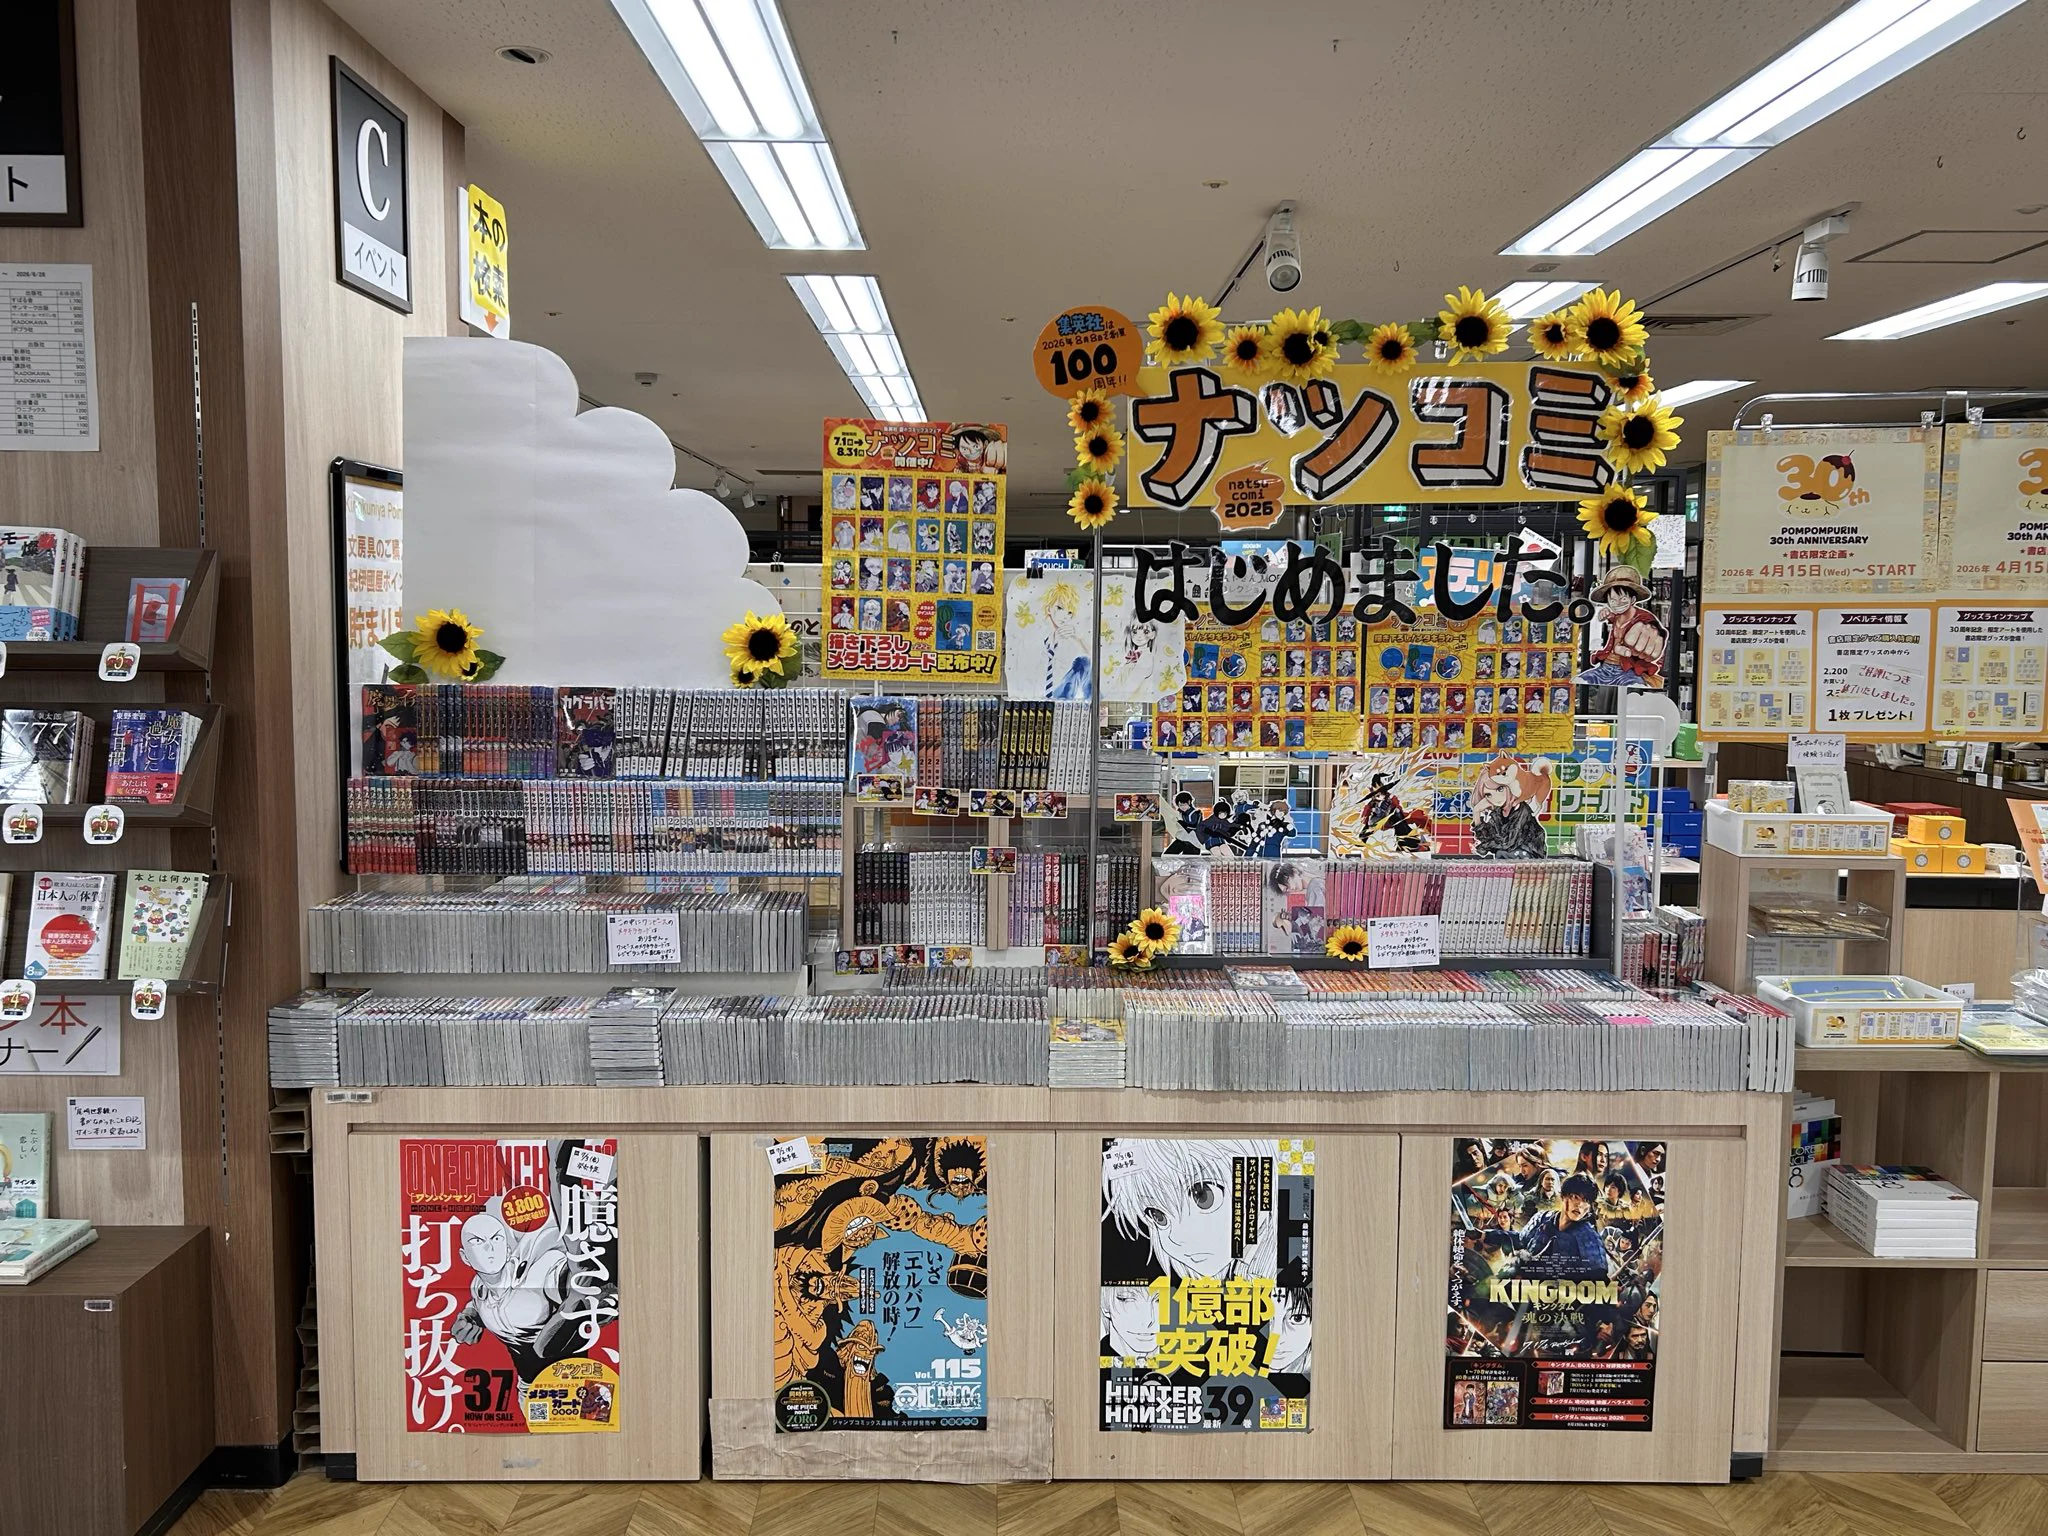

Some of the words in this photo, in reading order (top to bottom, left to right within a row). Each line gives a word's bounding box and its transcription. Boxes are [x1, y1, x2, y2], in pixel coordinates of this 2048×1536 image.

[356, 118, 391, 221] C
[8, 166, 28, 202] ト
[472, 199, 508, 250] 本の
[353, 242, 398, 283] イベント
[472, 254, 508, 309] 検索
[1050, 343, 1118, 386] 100
[865, 430, 957, 458] ナツコミ
[1128, 366, 1614, 508] ナツコミ
[894, 456, 934, 468] 開催中!
[1229, 478, 1269, 490] natsu
[1232, 489, 1264, 501] comi
[1225, 501, 1274, 518] 2026
[1781, 526, 1858, 536] POMPOMPURIN
[2007, 532, 2036, 541] 30th
[2019, 523, 2048, 532] POMP
[348, 536, 403, 560] 文房具のご購
[1770, 536, 1795, 545] 30th
[1797, 536, 1869, 545] ANNIVERSARY
[2027, 546, 2048, 556] 書店
[1789, 550, 1848, 560] 書店限定企画
[1721, 569, 1755, 578] 2026年
[1759, 565, 1821, 578] 4月15日
[1823, 568, 1851, 577] (Wed)
[1956, 565, 1990, 574] 2026年
[1996, 561, 2048, 574] 4月15
[1132, 536, 1597, 627] はじめました。
[1728, 616, 1792, 624] グッズラインナップ
[1846, 615, 1903, 623] ノベルティ情報
[1963, 613, 2028, 621] グッズラインナップ
[828, 633, 911, 651] 描き下ろし
[827, 652, 936, 671] メタキラカード
[936, 653, 998, 674] 配布中!
[561, 694, 616, 711] カグラバチ
[1828, 709, 1850, 722] 1枚
[1854, 710, 1913, 721] プレゼント!
[9, 722, 68, 745] 777
[164, 714, 183, 760] 魔女と
[109, 721, 128, 768] 七日間
[18, 814, 28, 833] 4
[134, 873, 191, 884] 本とは何か
[406, 1145, 549, 1198] ONEPUNCH
[1262, 1159, 1270, 1210] 一手先も読めない
[504, 1195, 544, 1217] 3,800
[559, 1184, 620, 1364] 臆さず、
[926, 1250, 944, 1285] いざ
[883, 1252, 900, 1342] 解放の時!
[904, 1250, 924, 1329] 「エルバフ」
[1489, 1278, 1619, 1307] KINGDOM
[1148, 1276, 1277, 1326] 1億部
[1533, 1302, 1575, 1311] キングダム
[402, 1214, 466, 1434] 打ち抜け。
[1522, 1312, 1585, 1325] 魂の決戦
[1156, 1328, 1280, 1378] 突破!
[552, 1363, 603, 1377] ナツコミ
[932, 1358, 982, 1379] 115
[464, 1368, 513, 1412] 37
[529, 1389, 568, 1399] メタキラ
[1106, 1381, 1202, 1404] HUNTER
[552, 1398, 581, 1408] カード
[1204, 1385, 1254, 1426] 39
[464, 1412, 483, 1421] NOW
[484, 1412, 494, 1421] ON
[496, 1412, 514, 1421] SALE
[786, 1415, 818, 1424] ZORO
[1202, 1419, 1222, 1429] 最新
